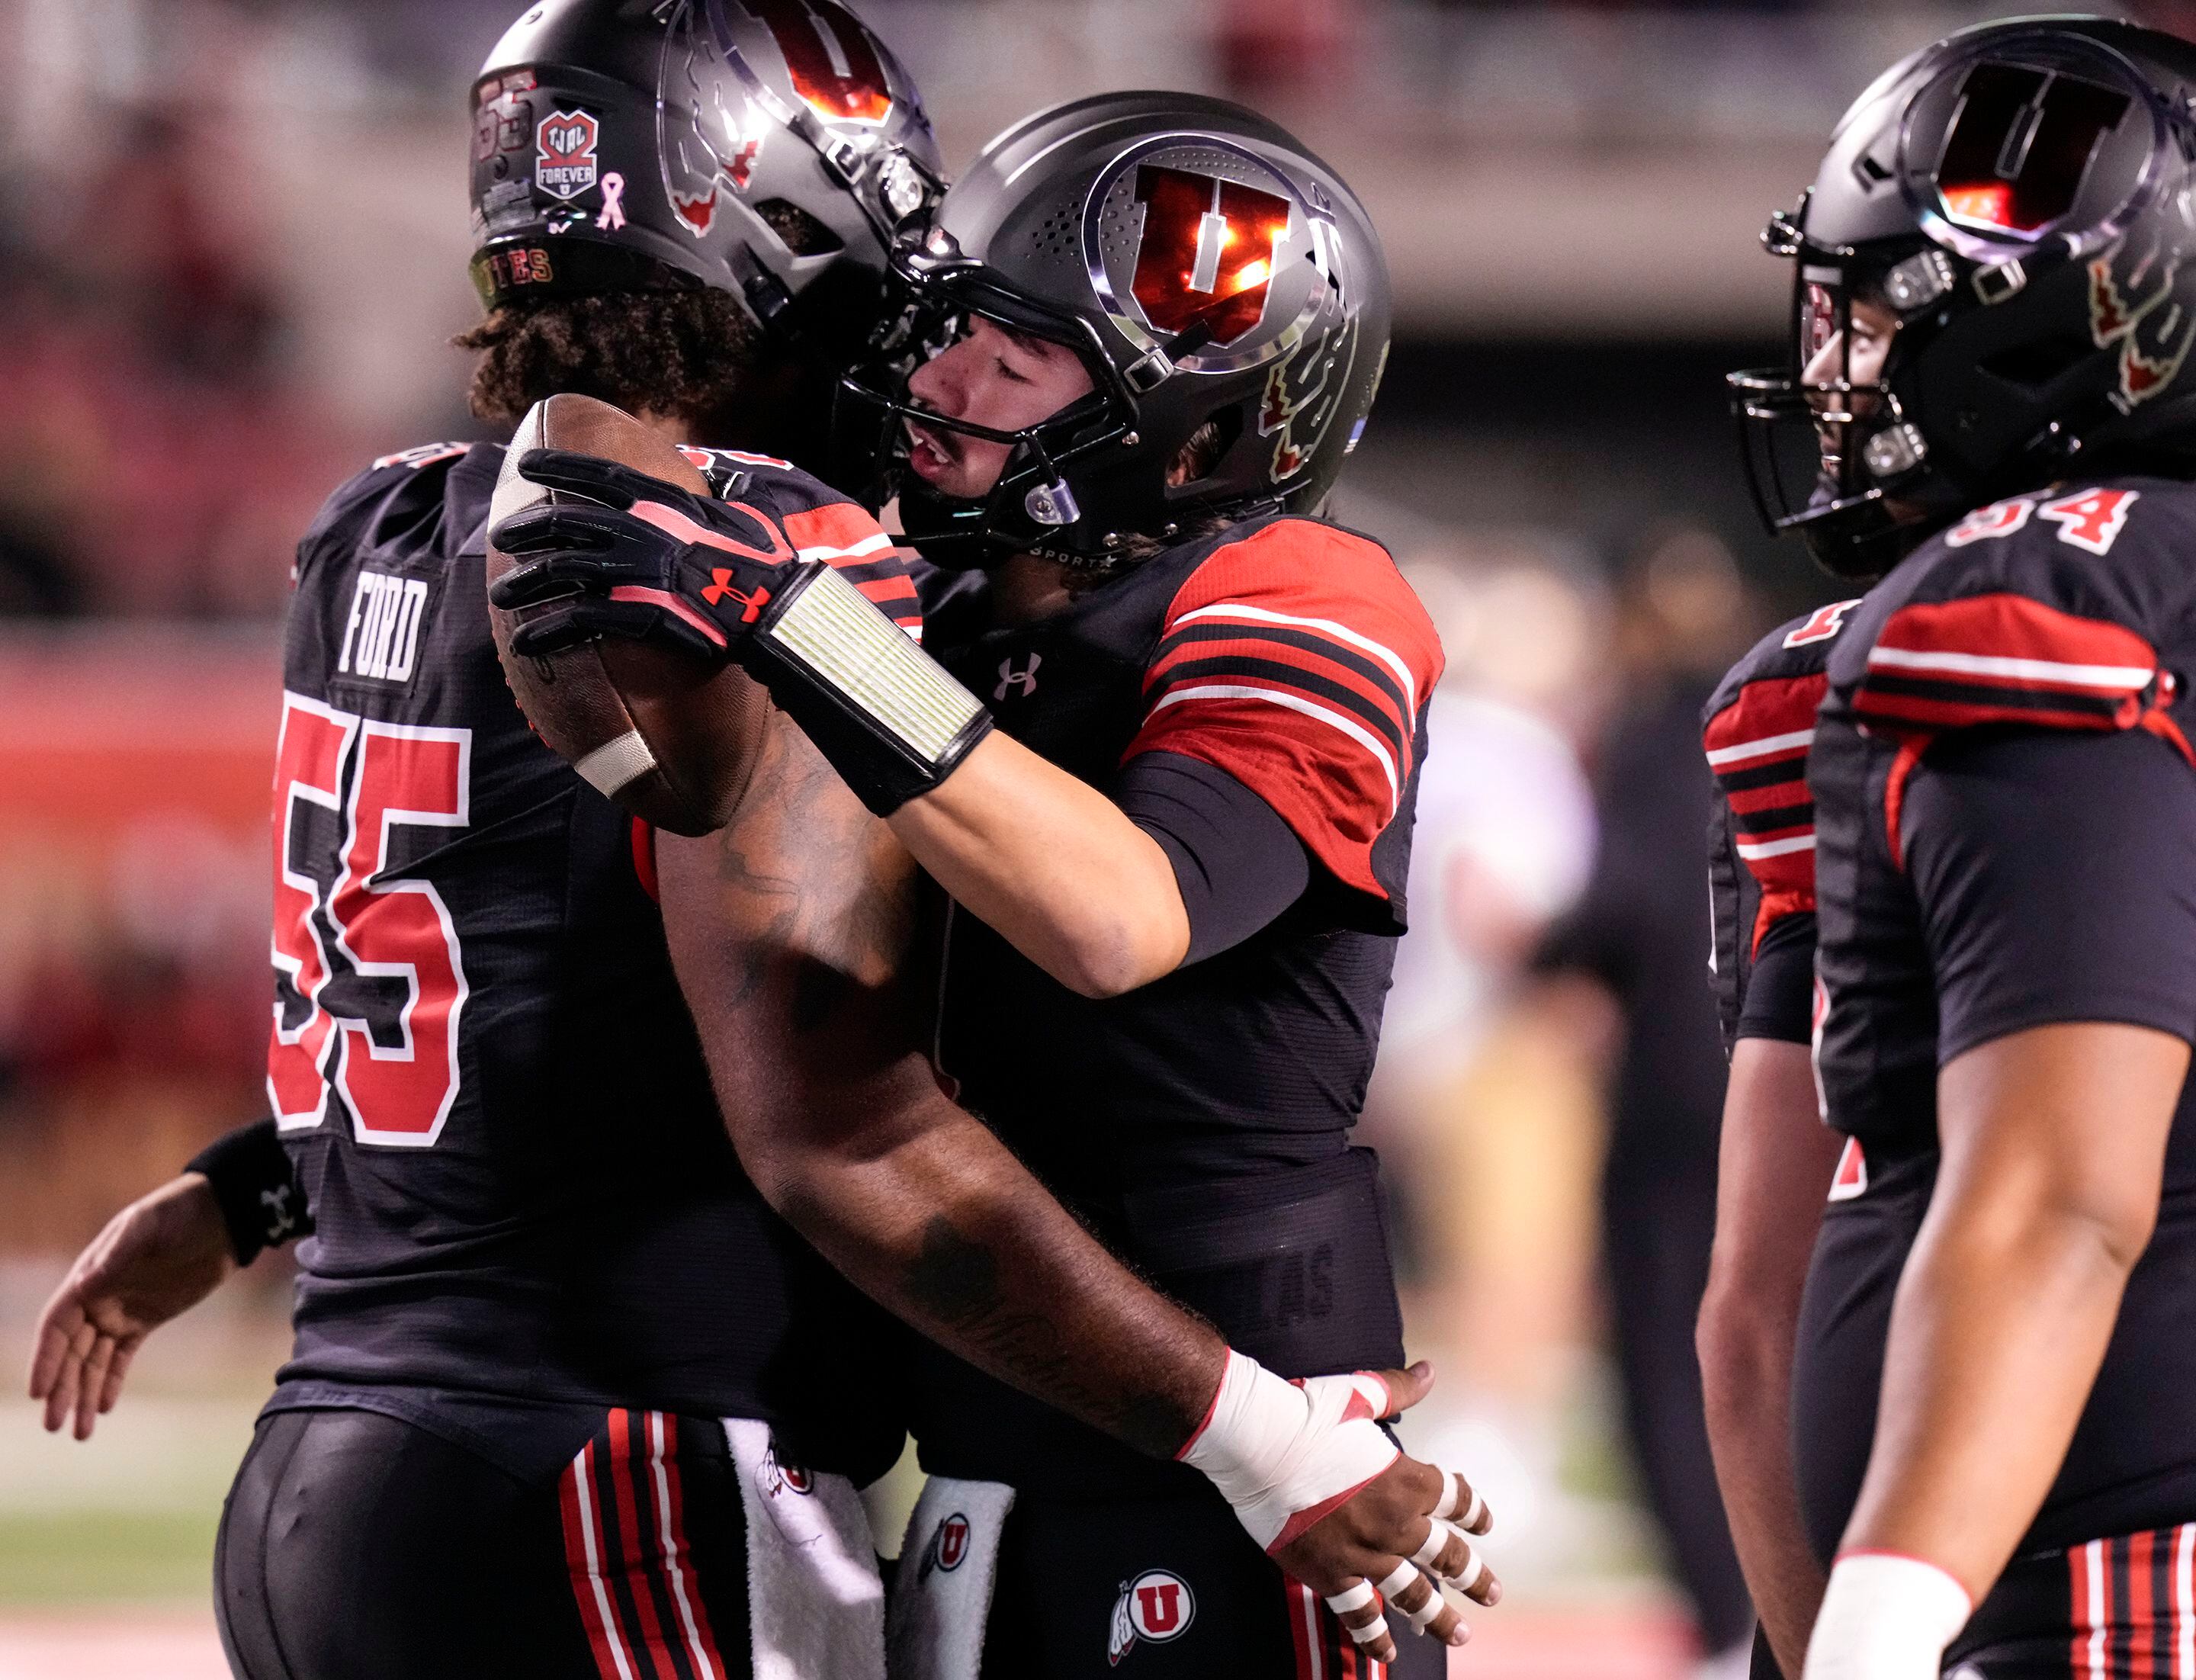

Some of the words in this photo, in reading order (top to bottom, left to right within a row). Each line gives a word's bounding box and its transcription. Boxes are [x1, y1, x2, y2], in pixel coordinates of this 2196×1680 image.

[540, 167, 592, 185] FOREVER
[1930, 58, 2137, 243] U
[1130, 163, 1292, 349] U
[1029, 546, 1097, 567] SPORT
[338, 571, 428, 682] FORD
[267, 690, 472, 1147] 55
[942, 1523, 968, 1565] U
[1136, 1583, 1180, 1633] U
